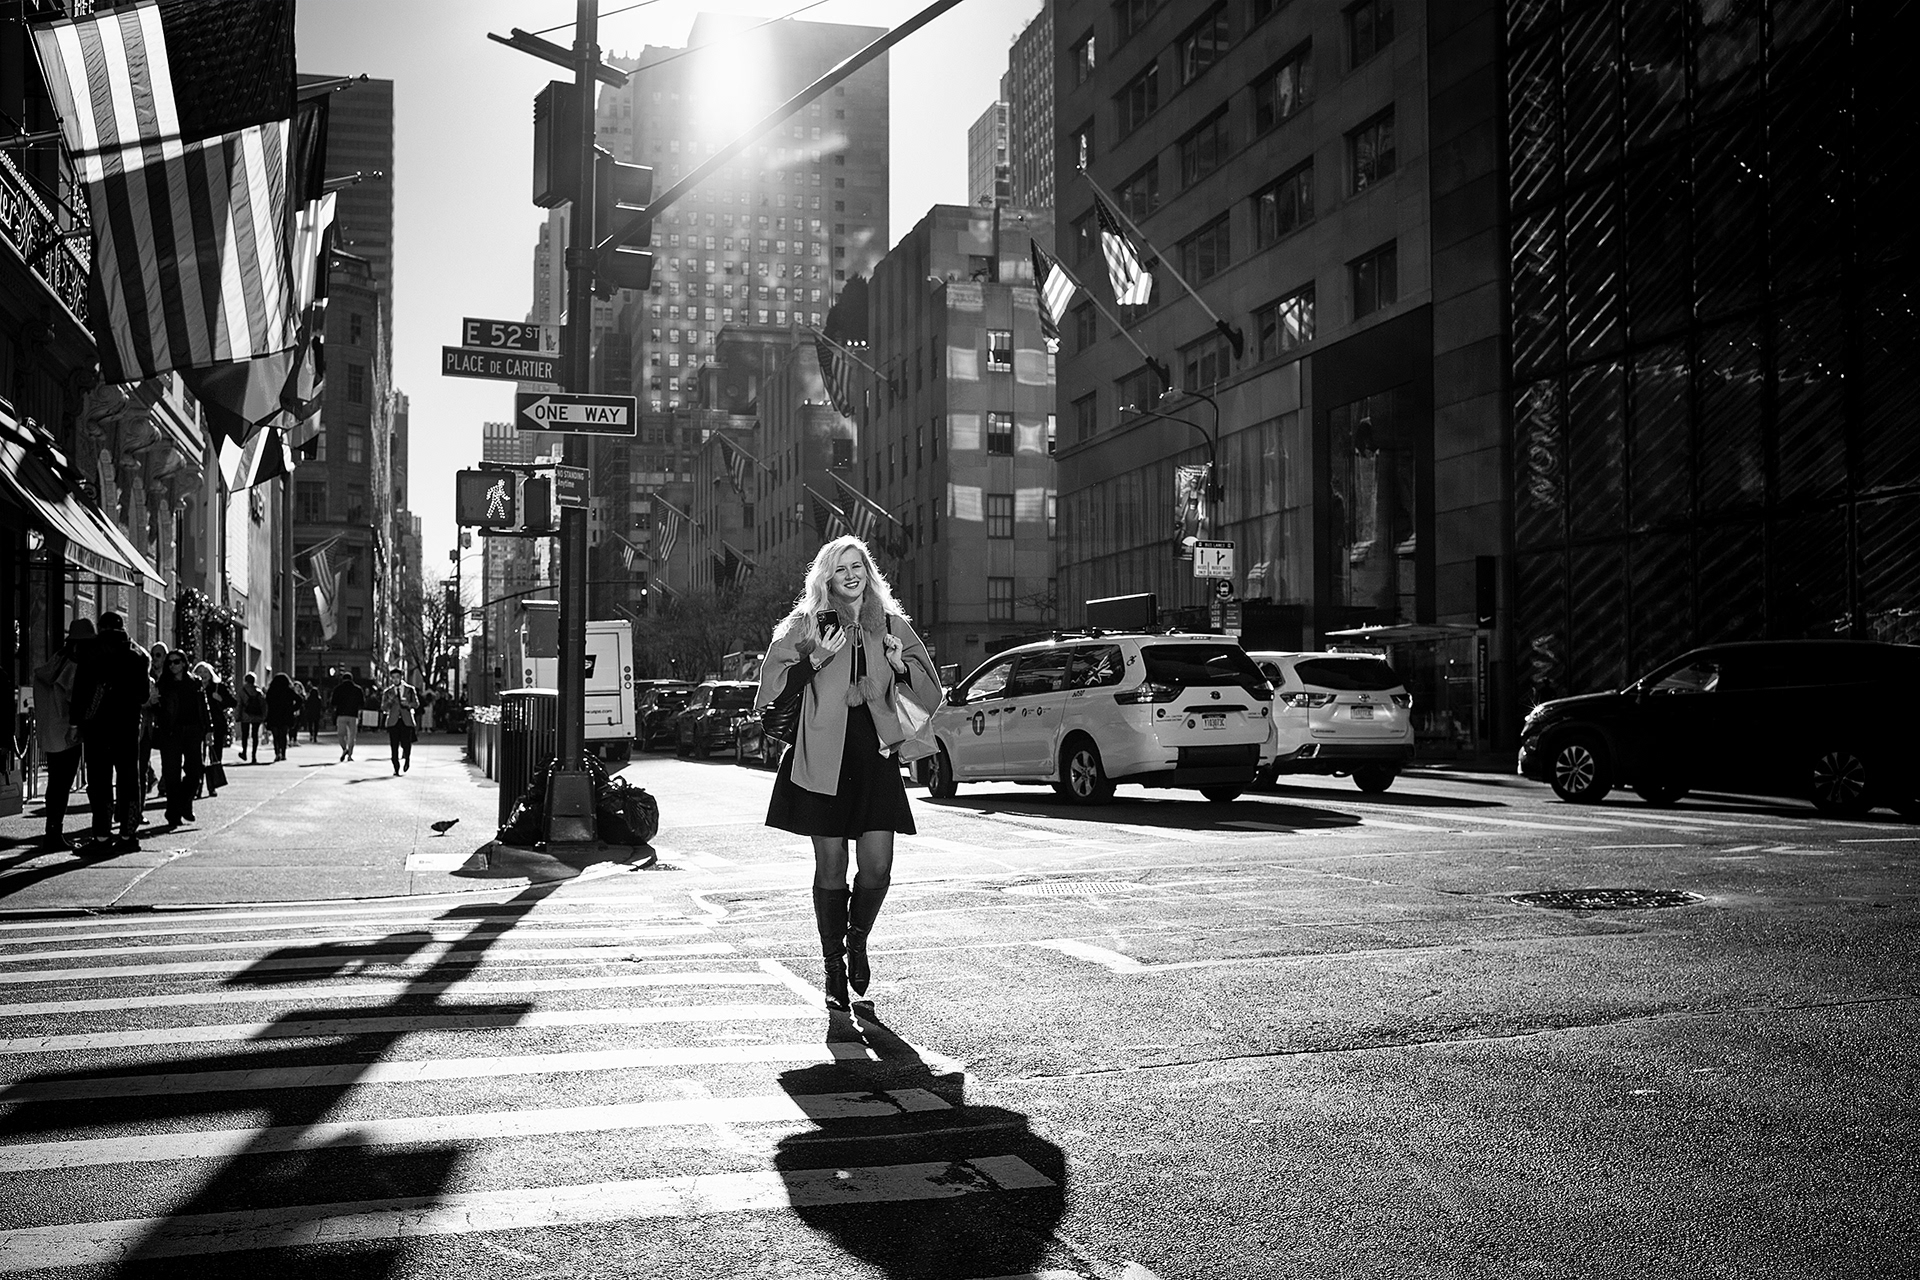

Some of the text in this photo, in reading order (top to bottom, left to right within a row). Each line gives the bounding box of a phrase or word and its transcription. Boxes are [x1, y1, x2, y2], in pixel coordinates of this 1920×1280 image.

[467, 322, 540, 347] E 52 ST
[447, 353, 484, 372] PLACE
[506, 358, 552, 378] CARTIER
[535, 405, 620, 423] ONE WAY
[557, 469, 585, 481] NO STANDING
